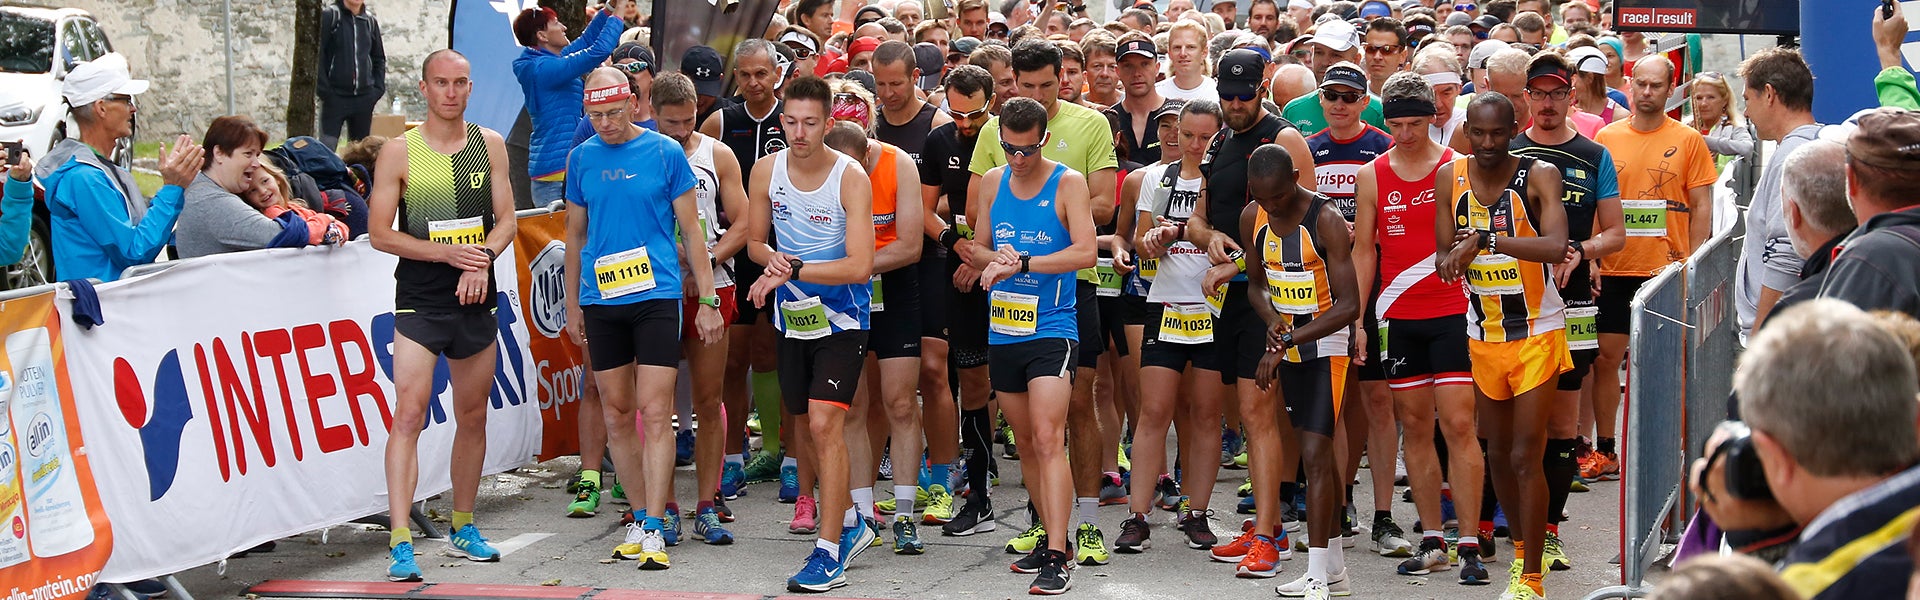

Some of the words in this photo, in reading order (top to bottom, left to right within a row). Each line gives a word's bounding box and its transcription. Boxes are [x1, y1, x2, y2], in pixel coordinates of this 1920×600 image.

[1316, 171, 1356, 189] trispo
[1624, 213, 1637, 224] PL
[1638, 213, 1659, 224] 447
[457, 232, 484, 245] 1114
[1141, 259, 1158, 271] HM
[598, 270, 616, 285] HM
[618, 262, 650, 280] 1118
[1485, 267, 1518, 282] 1108
[1284, 287, 1313, 300] 1107
[991, 305, 1005, 319] HM
[1007, 308, 1035, 323] 1029
[1163, 316, 1183, 330] HM
[1183, 318, 1212, 332] 1032
[1570, 323, 1585, 336] PL
[193, 290, 528, 484] INTERT
[537, 359, 585, 421] Spor
